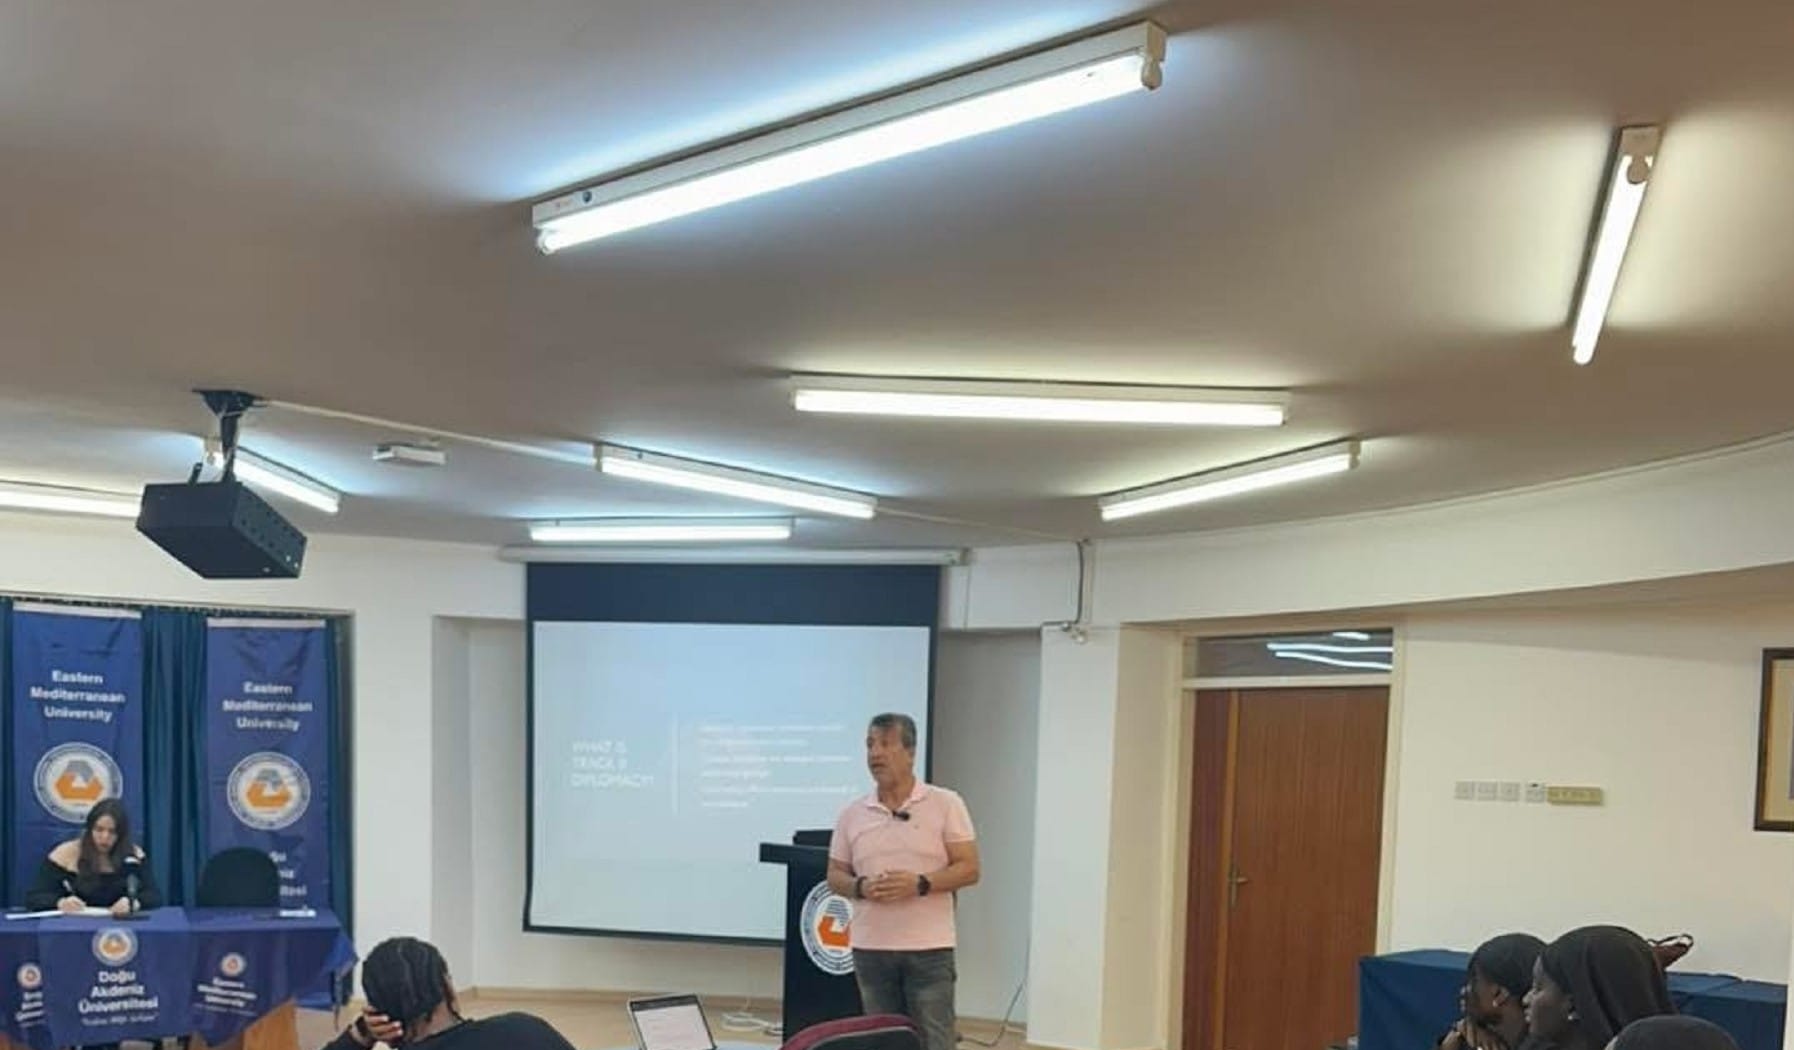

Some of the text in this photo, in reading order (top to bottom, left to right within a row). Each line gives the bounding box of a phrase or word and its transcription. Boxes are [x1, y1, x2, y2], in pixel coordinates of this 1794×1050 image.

[51, 669, 104, 684] Eastern
[29, 686, 126, 703] Mediterranean
[242, 681, 293, 694] Eastern
[222, 699, 313, 712] Mediterranean
[43, 705, 113, 723] University
[235, 716, 300, 732] University
[98, 970, 136, 983] Doğu
[90, 984, 145, 998] Akdeniz
[77, 996, 159, 1014] Üniversitesi
